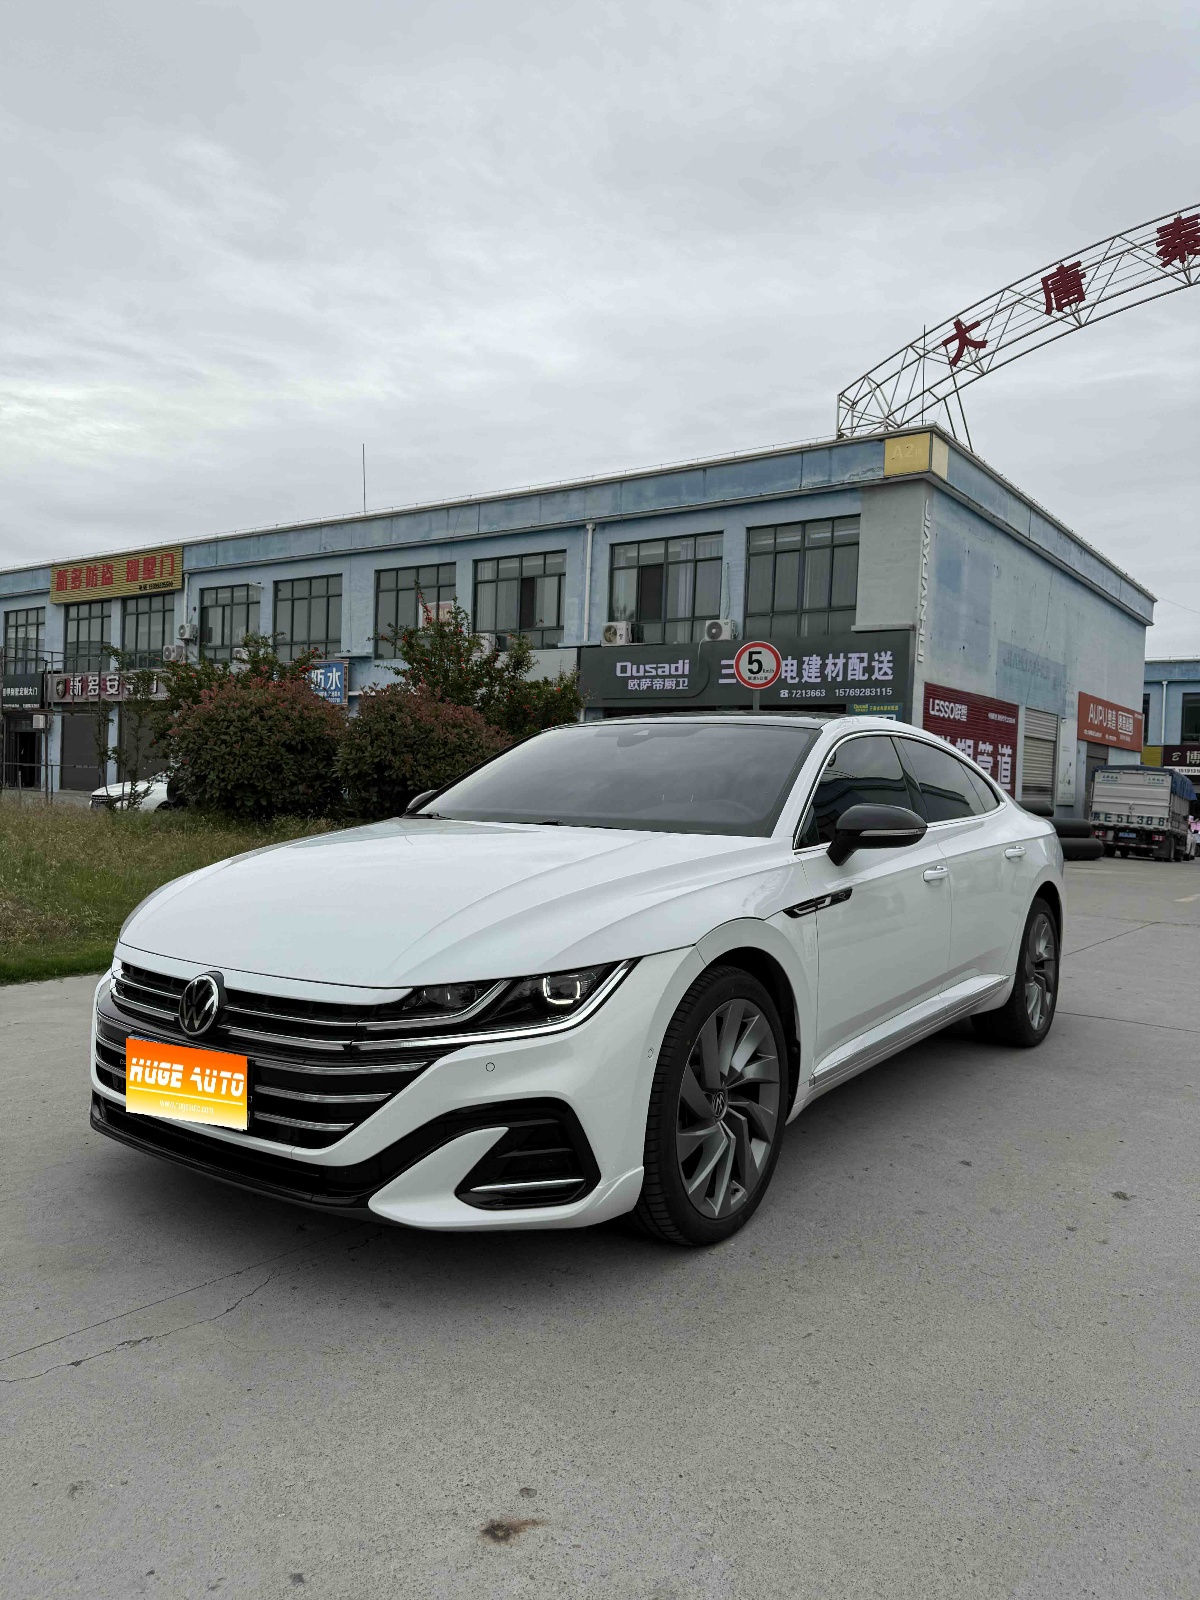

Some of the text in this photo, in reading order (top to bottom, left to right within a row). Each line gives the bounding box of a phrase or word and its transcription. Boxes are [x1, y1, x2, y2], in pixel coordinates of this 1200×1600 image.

[616, 659, 690, 677] Ousadi
[718, 650, 894, 685] 三电建材配送
[747, 650, 763, 675] 5
[628, 677, 689, 691] 欧萨帝厨卫
[791, 687, 893, 698] 7213663 15769283115
